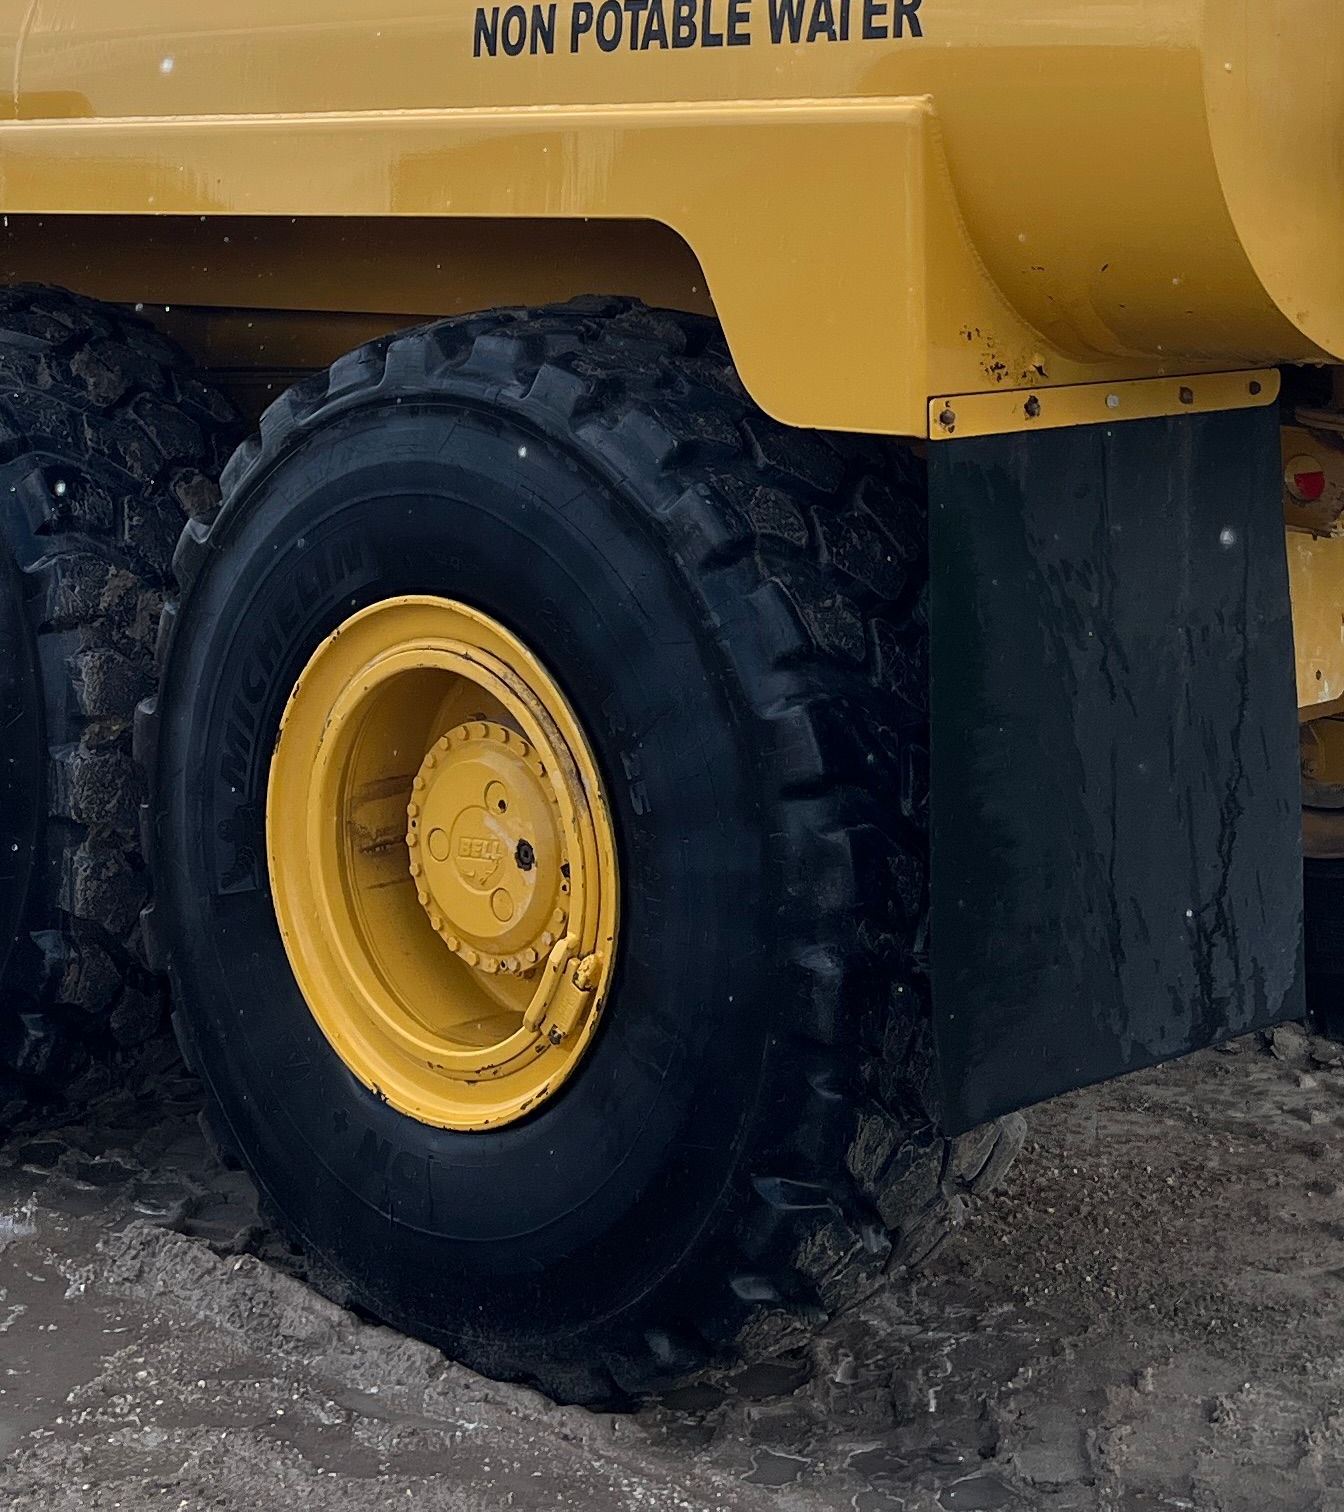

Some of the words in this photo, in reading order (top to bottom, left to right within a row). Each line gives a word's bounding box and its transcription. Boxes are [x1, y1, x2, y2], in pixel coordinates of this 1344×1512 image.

[472, 4, 557, 58] NON
[220, 530, 371, 795] MICHELIN
[458, 836, 502, 860] BELL
